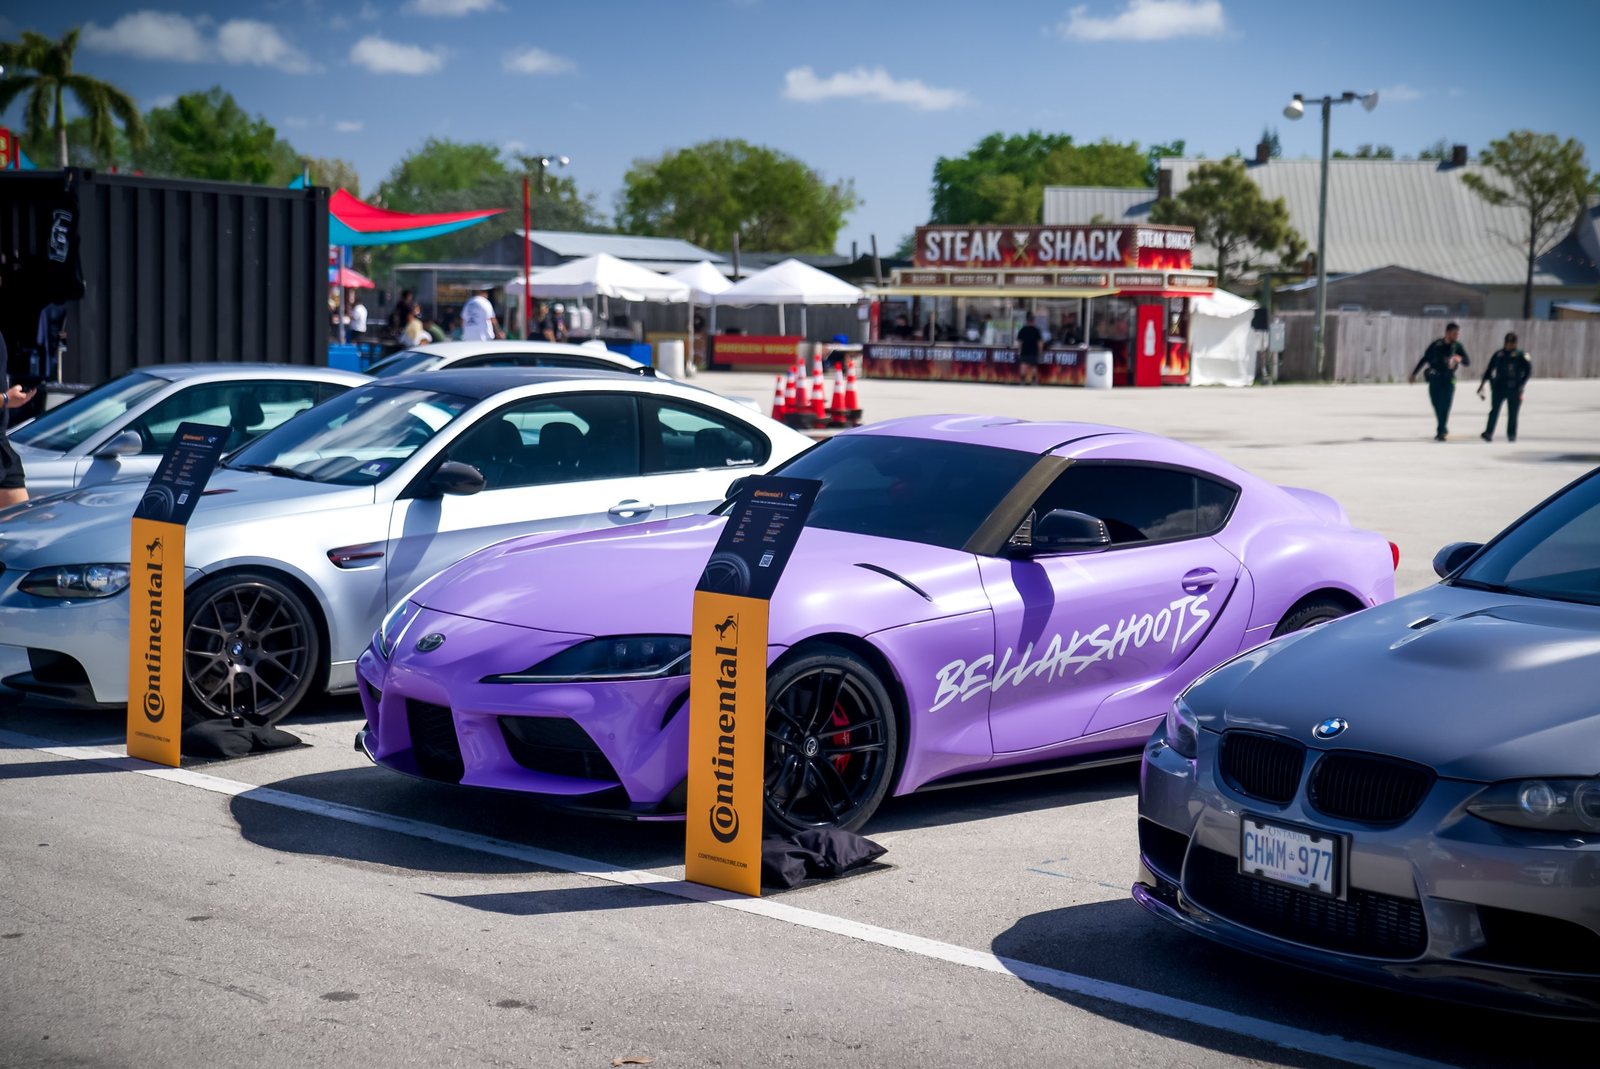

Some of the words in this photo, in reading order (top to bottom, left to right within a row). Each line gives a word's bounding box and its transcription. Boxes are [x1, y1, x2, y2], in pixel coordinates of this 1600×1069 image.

[925, 231, 1002, 262] STEAK
[1038, 230, 1122, 262] SHACK
[1137, 230, 1164, 248] STEAK
[1165, 231, 1193, 250] SHACK
[763, 344, 797, 355] WING
[870, 346, 912, 359] WELCOME
[912, 347, 924, 360] TO
[926, 348, 953, 361] STEAK
[954, 348, 987, 362] SHACK!
[993, 350, 1017, 363] NICE
[1055, 352, 1077, 365] YOU!
[143, 563, 165, 723] Continental
[928, 594, 1210, 713] BELLAKSHOOTS
[709, 646, 739, 844] Continental
[697, 852, 748, 869] CONTINENTALTIRE.COM
[1244, 831, 1286, 871] CHWM
[1298, 846, 1332, 881] 977
